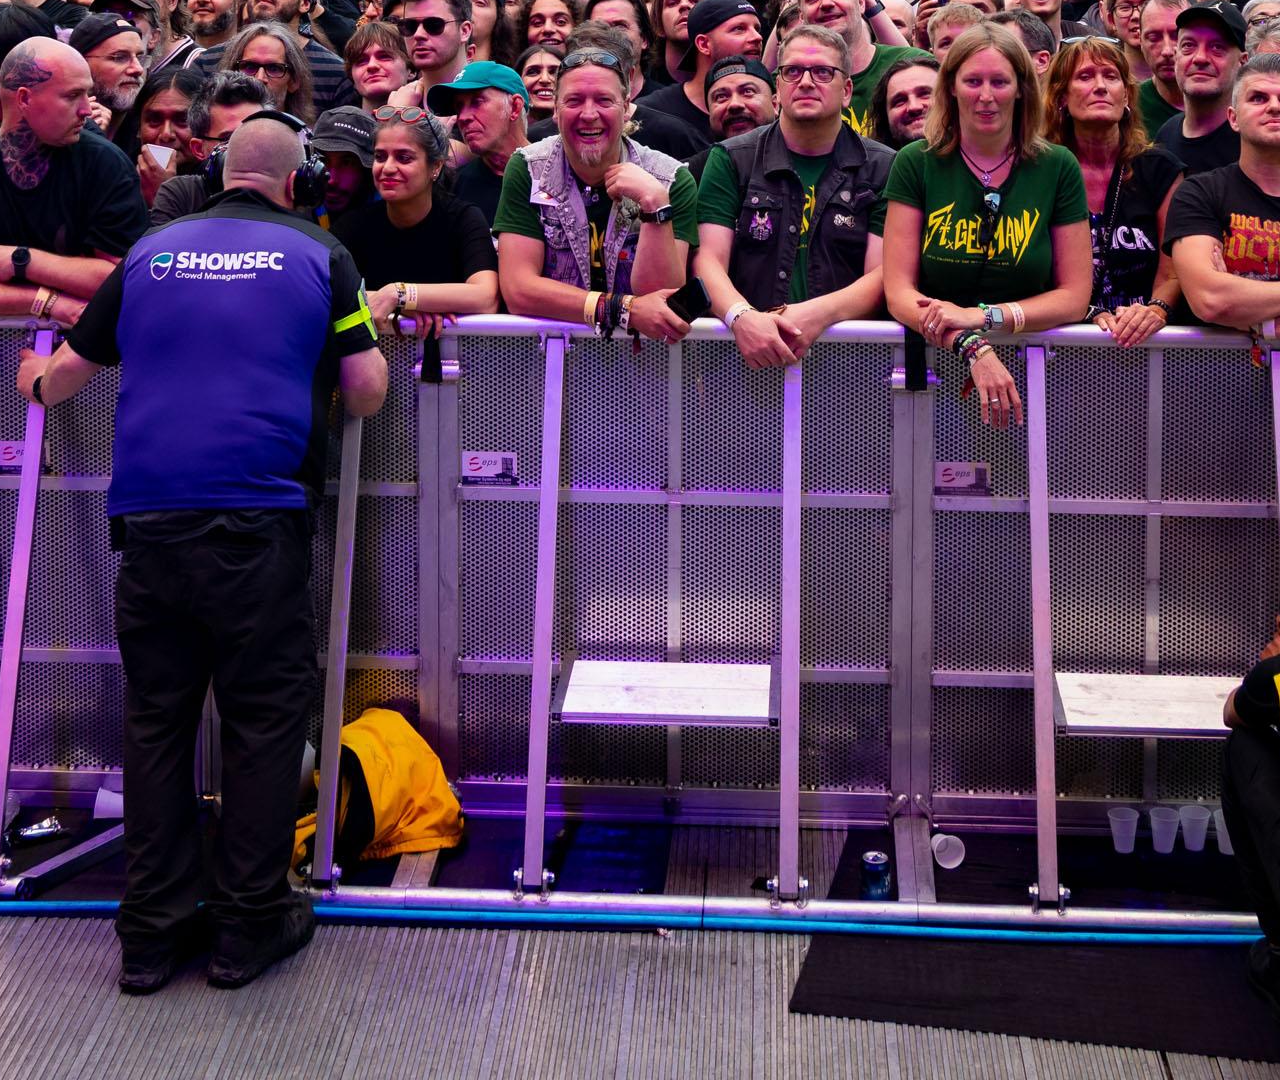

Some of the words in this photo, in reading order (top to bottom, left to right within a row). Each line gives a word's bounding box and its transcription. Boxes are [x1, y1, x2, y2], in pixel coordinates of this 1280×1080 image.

[175, 251, 285, 271] SHOWSEC
[175, 271, 203, 280] Crowd
[204, 272, 257, 281] Management
[482, 458, 497, 467] eps
[954, 470, 970, 478] eps
